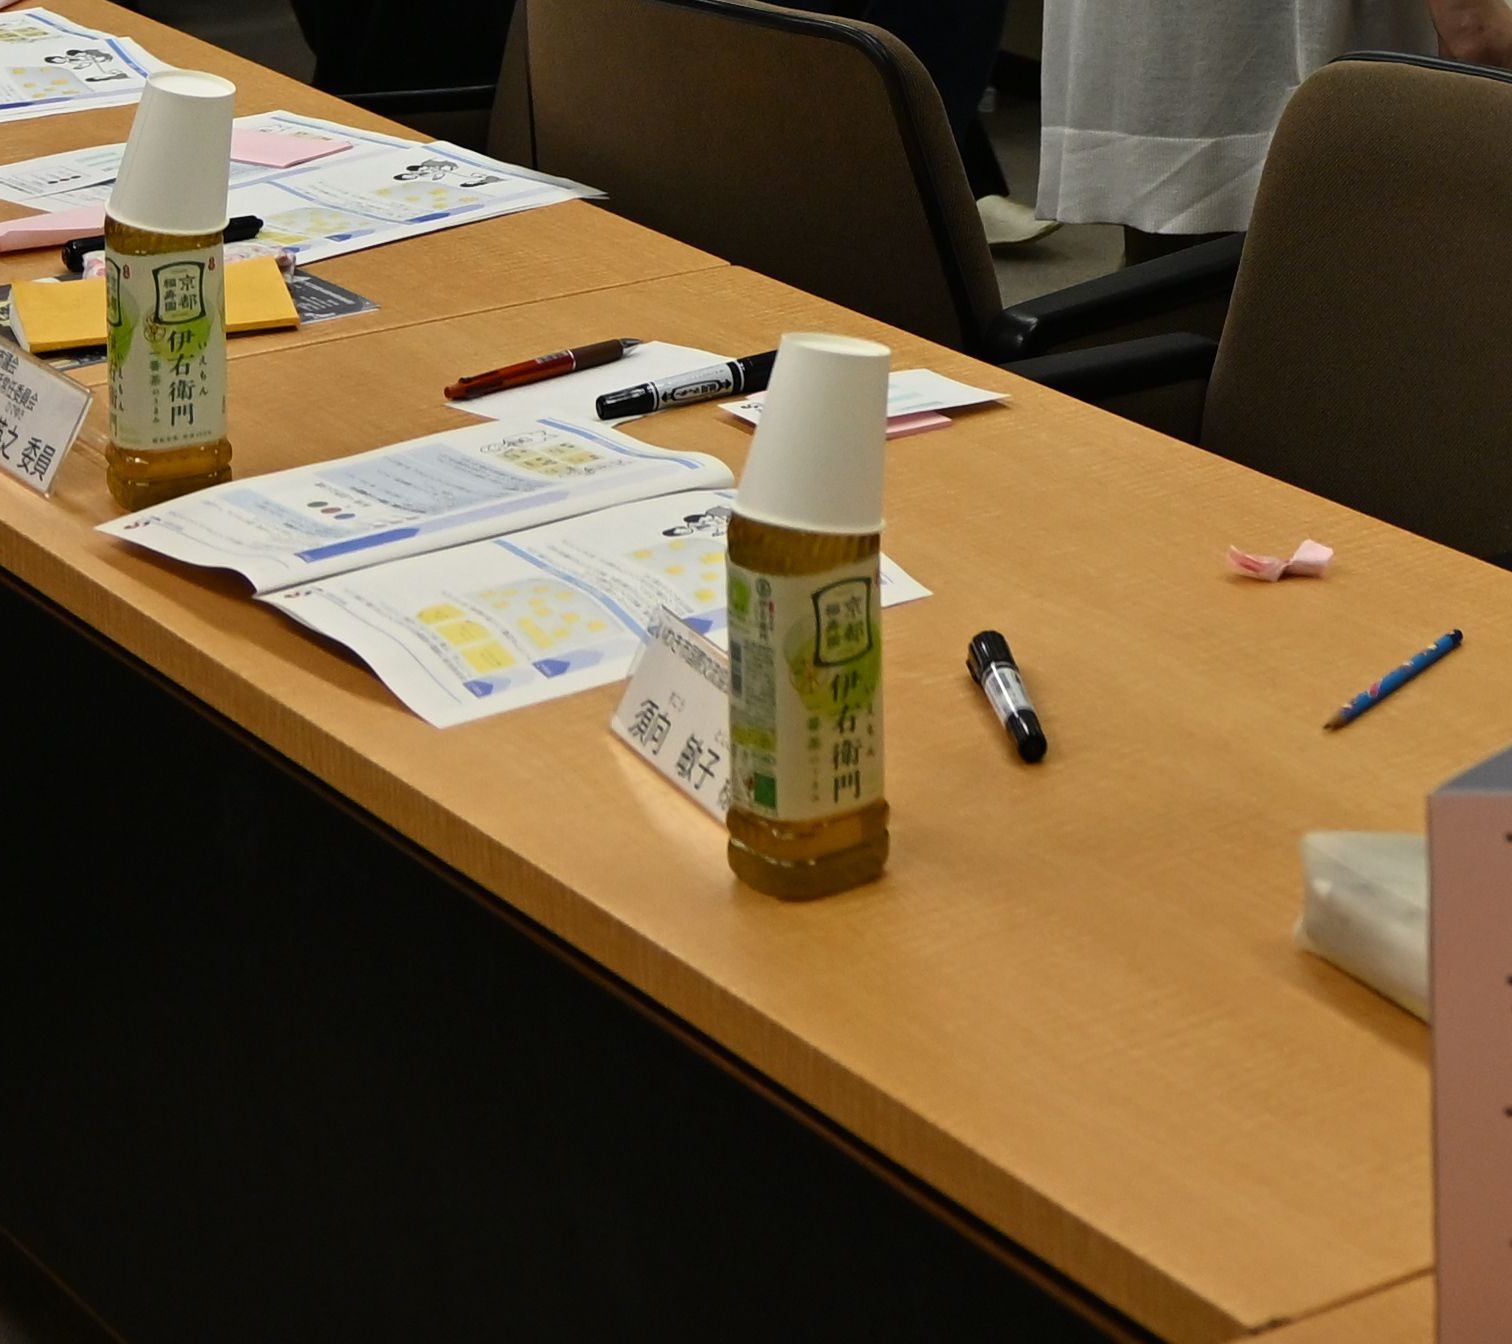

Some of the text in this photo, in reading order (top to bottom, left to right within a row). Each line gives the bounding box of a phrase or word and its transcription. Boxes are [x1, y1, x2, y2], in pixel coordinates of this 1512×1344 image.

[163, 277, 177, 313] 福寿園
[178, 274, 198, 312] 京都
[168, 330, 196, 427] 伊右衛門
[198, 341, 209, 397] いえもん
[16, 436, 56, 482] 委員
[844, 595, 865, 643] 京都
[832, 670, 861, 804] 伊右衛門
